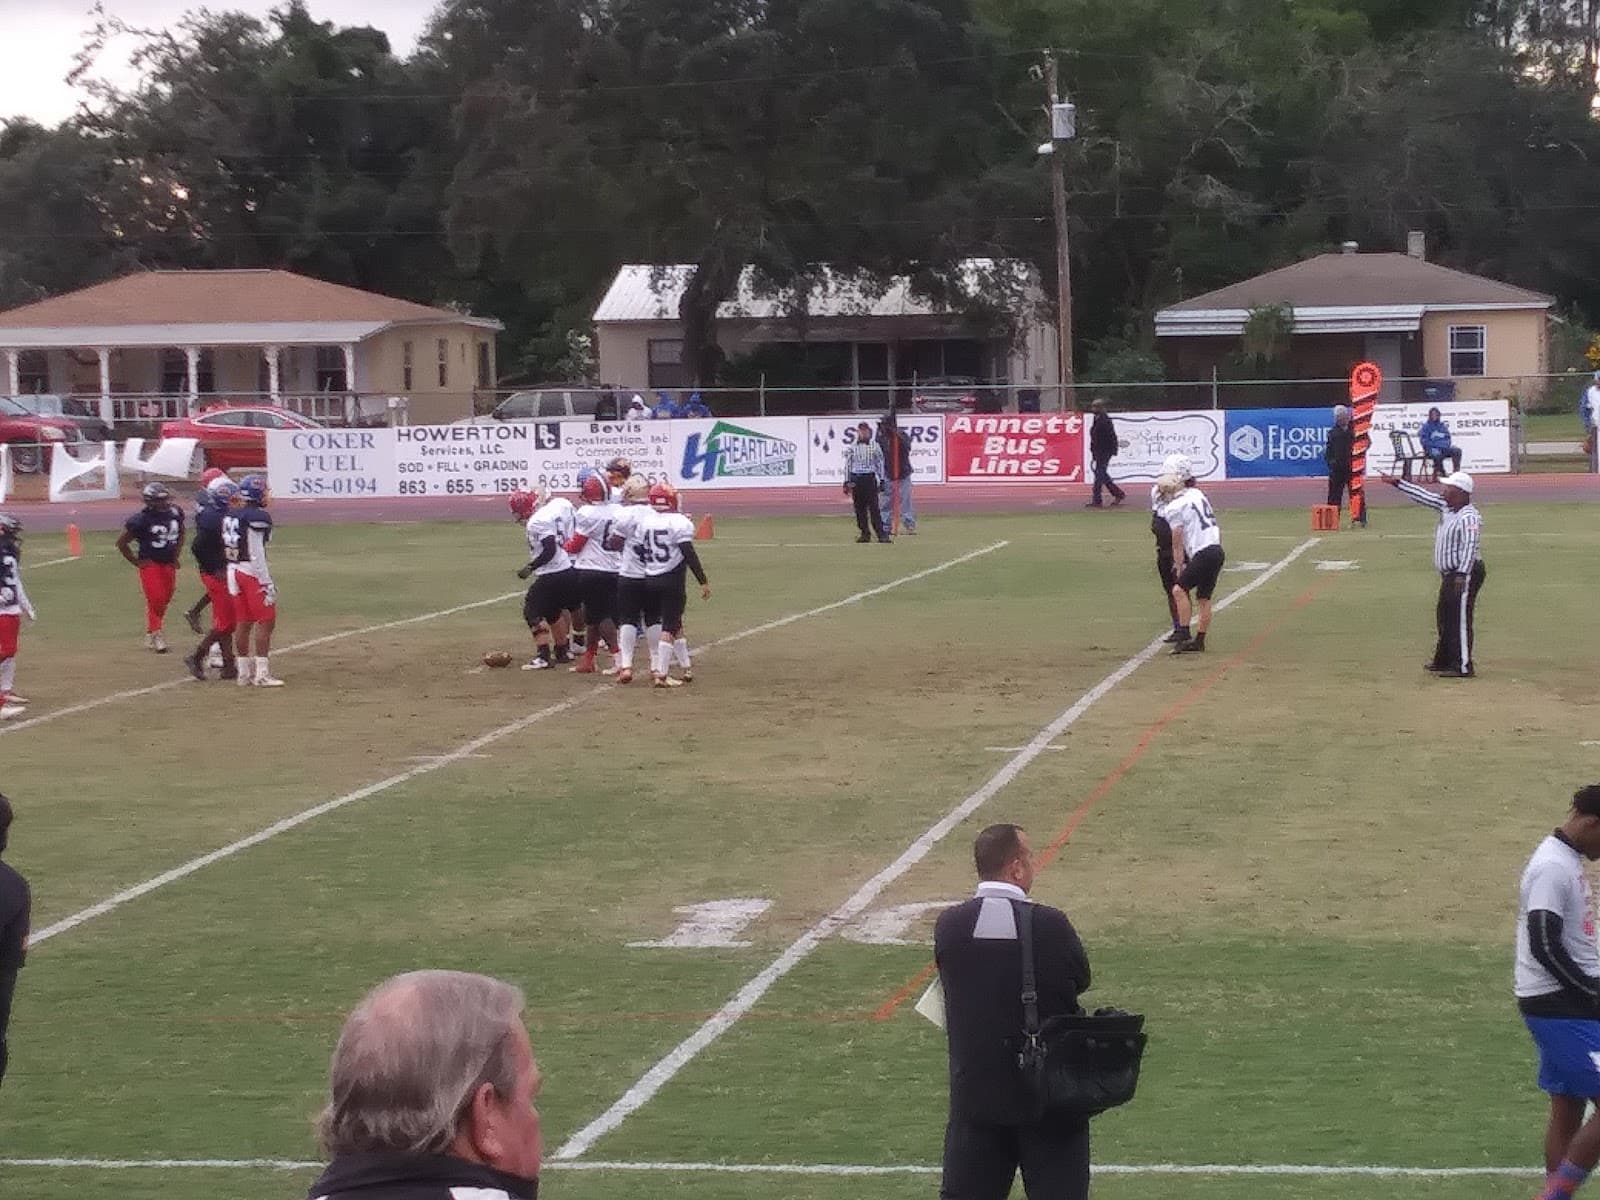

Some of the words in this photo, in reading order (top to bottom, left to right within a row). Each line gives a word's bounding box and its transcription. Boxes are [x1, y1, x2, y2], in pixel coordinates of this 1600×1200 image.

[590, 422, 642, 434] Bevis
[949, 416, 1082, 434] Annett
[292, 433, 375, 450] COKER
[397, 426, 527, 442] HOWERTON
[575, 447, 649, 457] Commercial
[723, 433, 798, 465] HEARTLAND
[983, 436, 1047, 455] Bus
[304, 455, 364, 472] FUEL
[398, 462, 424, 473] SOD
[436, 461, 461, 472] FILL
[473, 460, 529, 472] GRADING
[541, 459, 589, 471] Custom
[970, 457, 1060, 474] Lines
[291, 477, 377, 494] 385-0194
[398, 479, 427, 494] 863
[445, 479, 475, 493] 655
[150, 519, 180, 549] 34
[640, 528, 672, 563] 45
